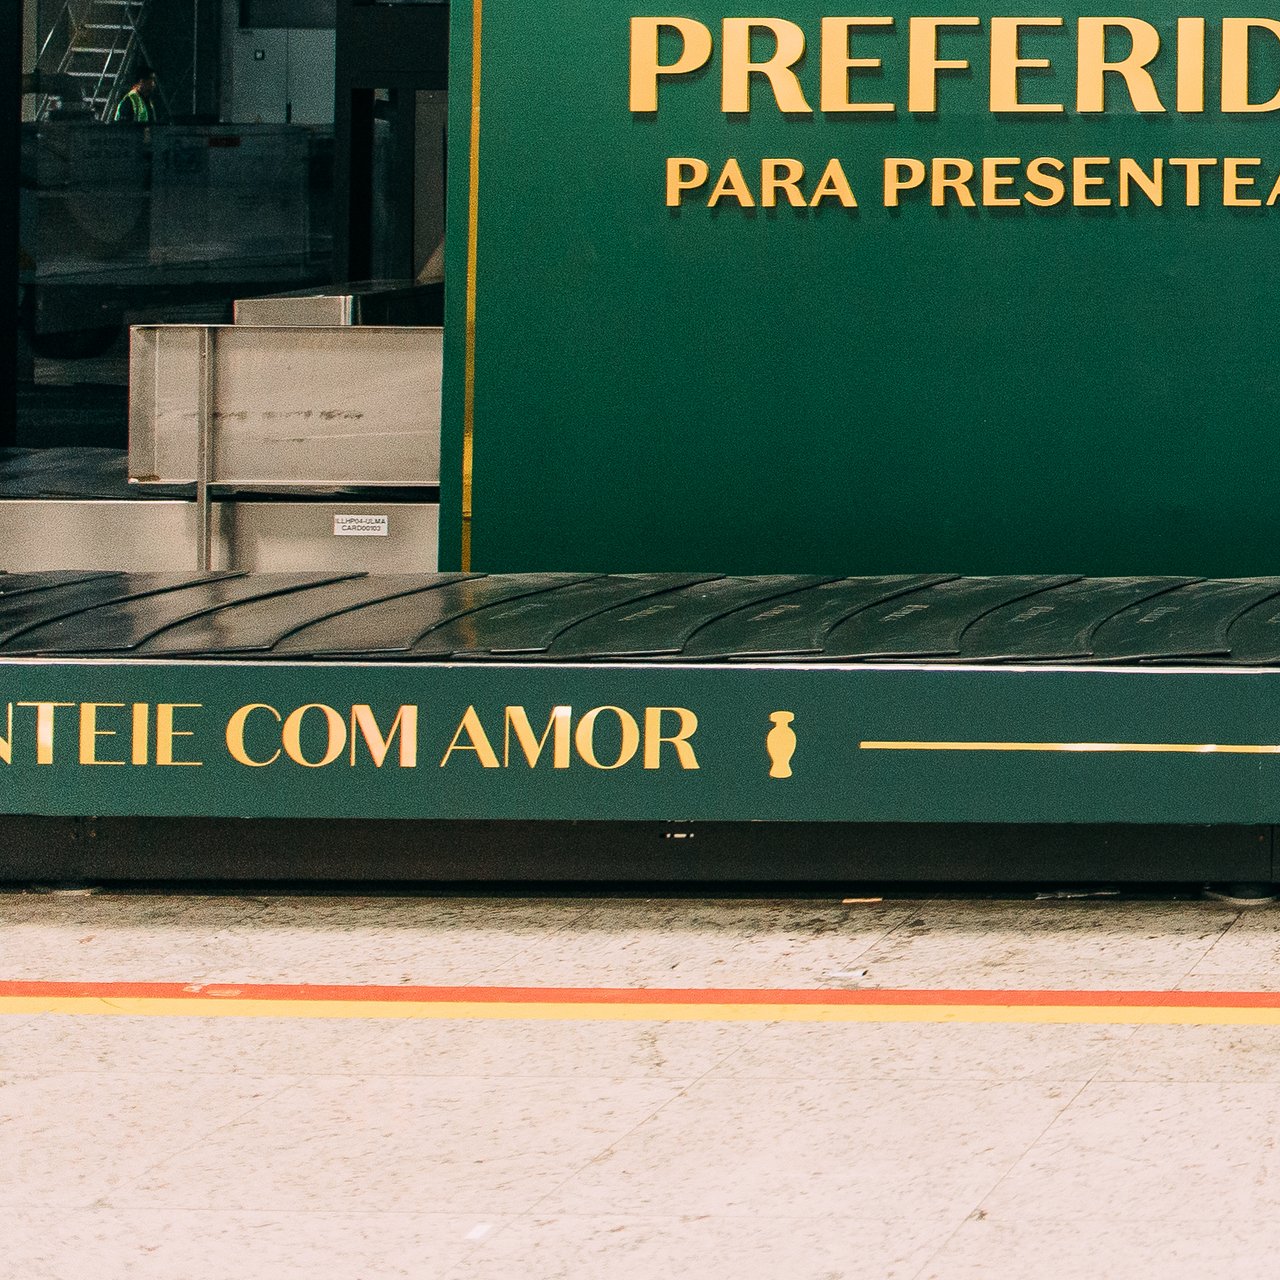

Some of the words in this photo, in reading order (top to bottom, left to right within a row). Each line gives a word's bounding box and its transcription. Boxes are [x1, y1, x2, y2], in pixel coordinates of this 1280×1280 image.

[666, 158, 857, 208] PARA
[0, 702, 203, 767] TEIE
[225, 703, 418, 769] COM
[441, 704, 701, 771] AMOR
